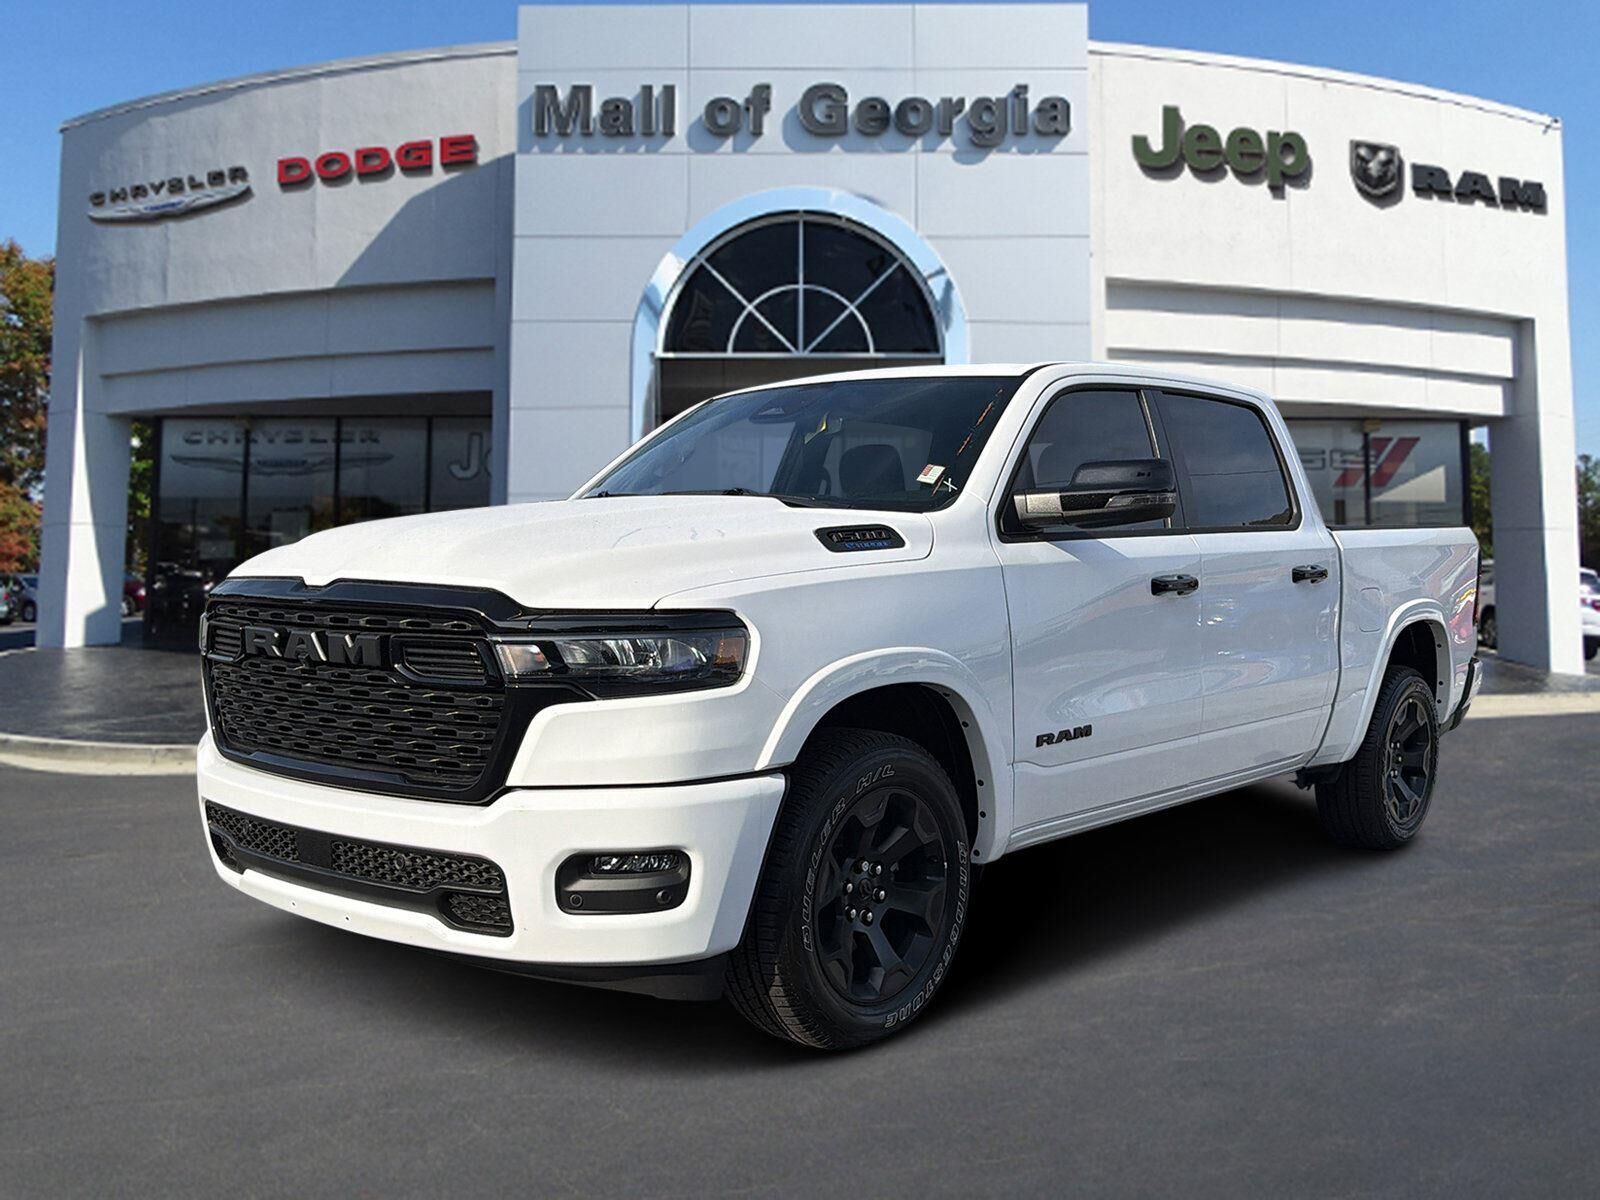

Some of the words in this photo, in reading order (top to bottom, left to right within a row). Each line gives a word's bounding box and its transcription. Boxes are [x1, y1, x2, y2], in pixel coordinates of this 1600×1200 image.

[532, 84, 676, 138] Mall
[703, 83, 772, 137] of
[800, 83, 1072, 148] Georgia
[276, 134, 478, 187] DODGE
[1132, 105, 1309, 198] Jeep
[89, 166, 249, 207] CHRYSLER
[1411, 162, 1548, 214] RAM
[244, 625, 383, 667] RAM
[1035, 724, 1093, 748] RAM
